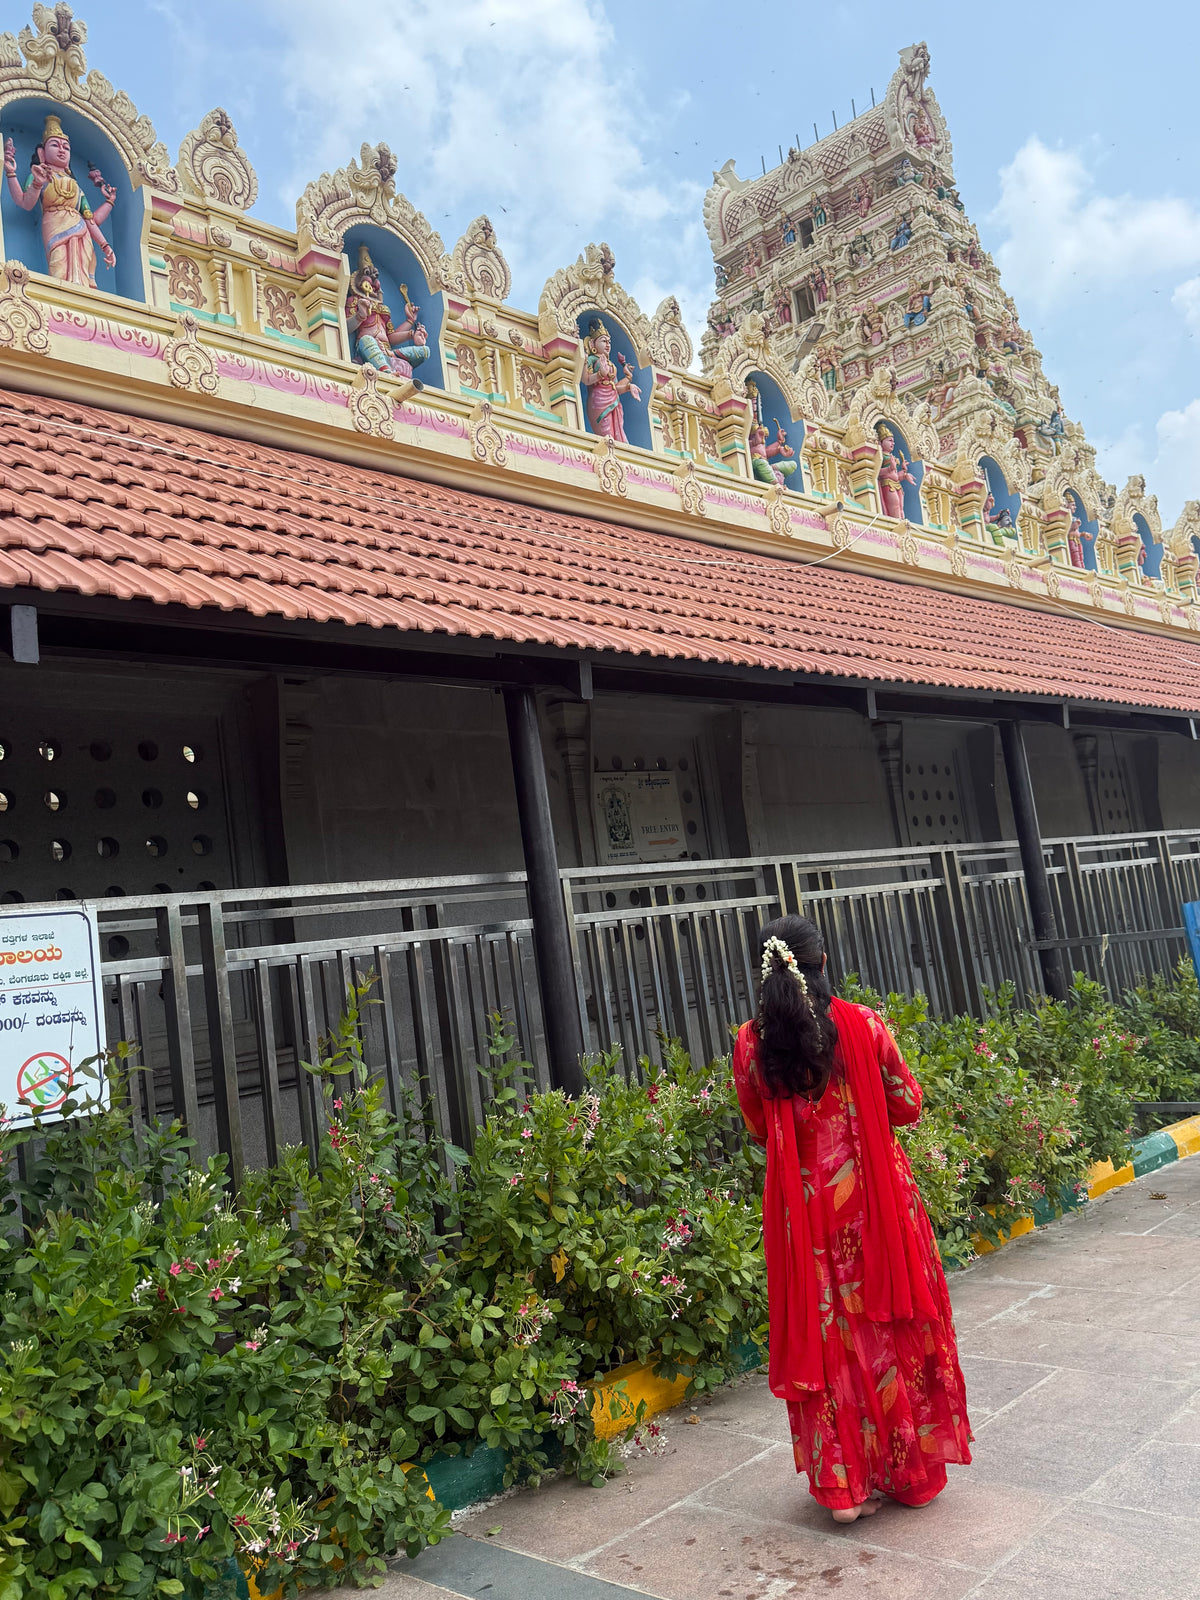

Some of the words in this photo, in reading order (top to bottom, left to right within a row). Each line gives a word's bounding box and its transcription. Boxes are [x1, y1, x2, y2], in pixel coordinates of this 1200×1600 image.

[660, 823, 679, 833] ENTRY
[32, 931, 55, 941] ಇಲಾಖೆ
[9, 972, 50, 984] ಬೆಂಗಳೂರು
[53, 971, 71, 982] ದಕ್ಷಿಣ
[12, 989, 58, 1006] ಕಸವನ್ನು
[36, 1008, 87, 1026] ದಂಡವನ್ನು
